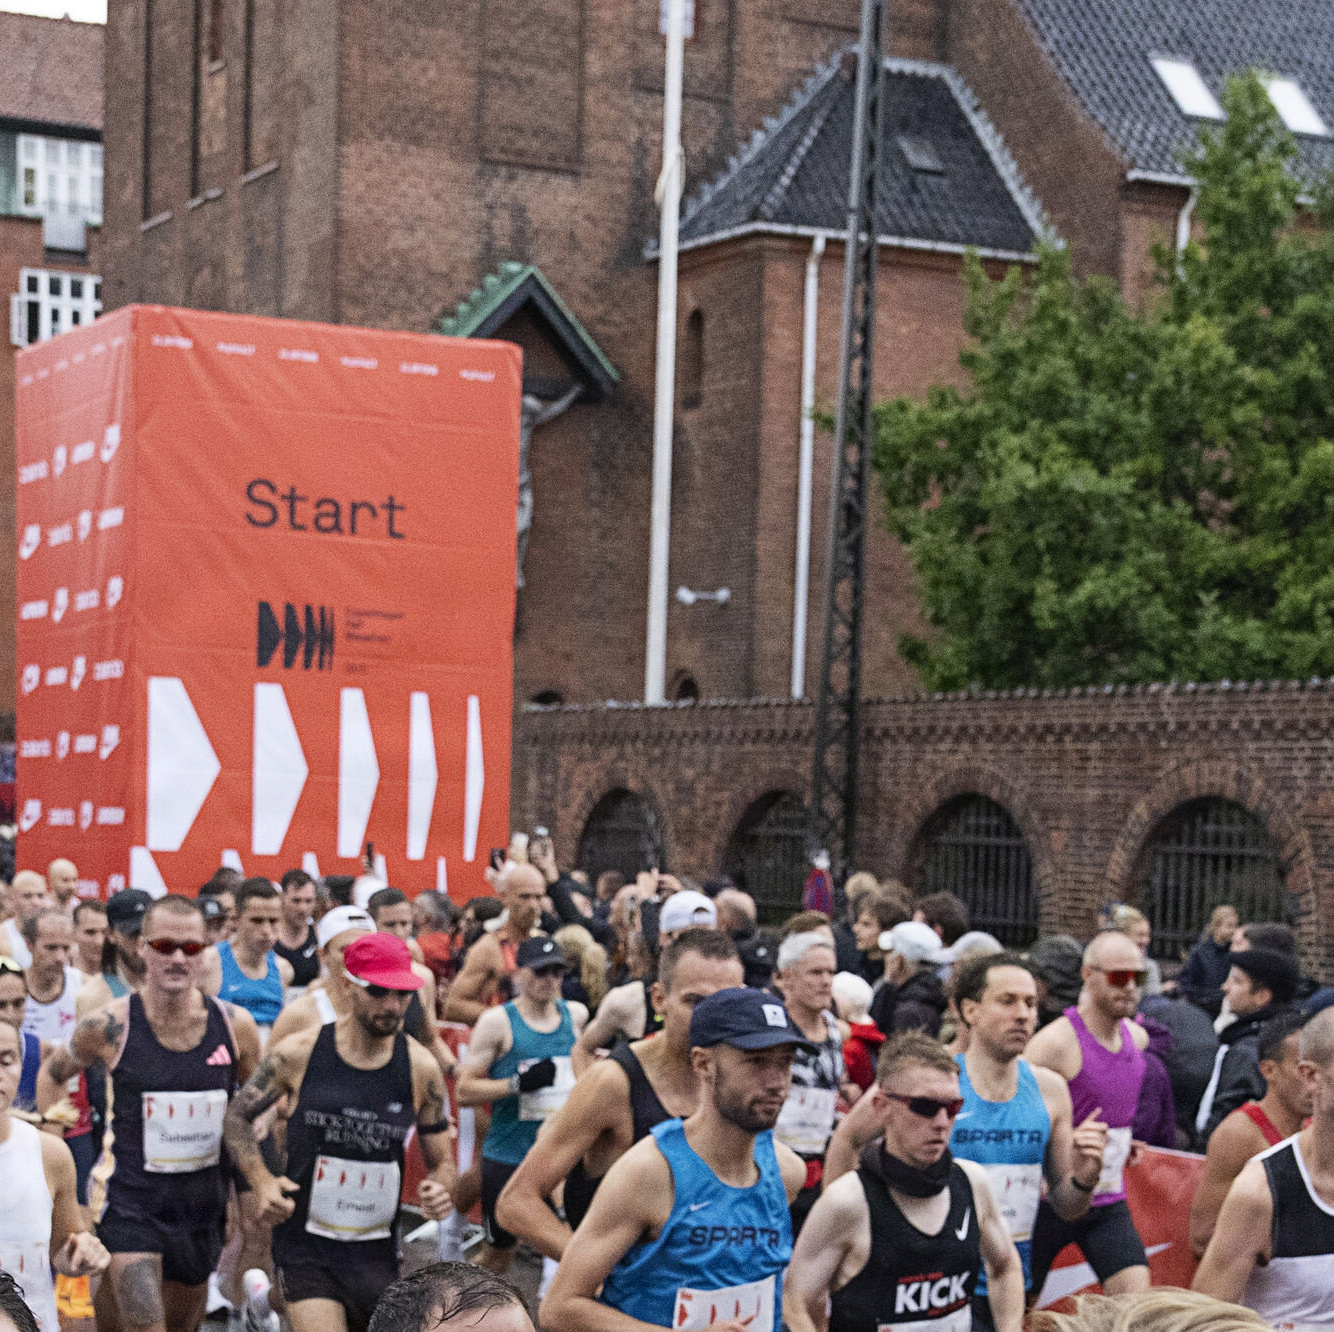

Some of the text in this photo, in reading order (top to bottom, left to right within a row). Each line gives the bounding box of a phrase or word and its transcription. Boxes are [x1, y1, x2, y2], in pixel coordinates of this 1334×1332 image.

[245, 477, 407, 540] Start
[954, 1127, 1044, 1145] SPARTA
[688, 1224, 780, 1249] SPARTA
[894, 1270, 971, 1315] KICK
